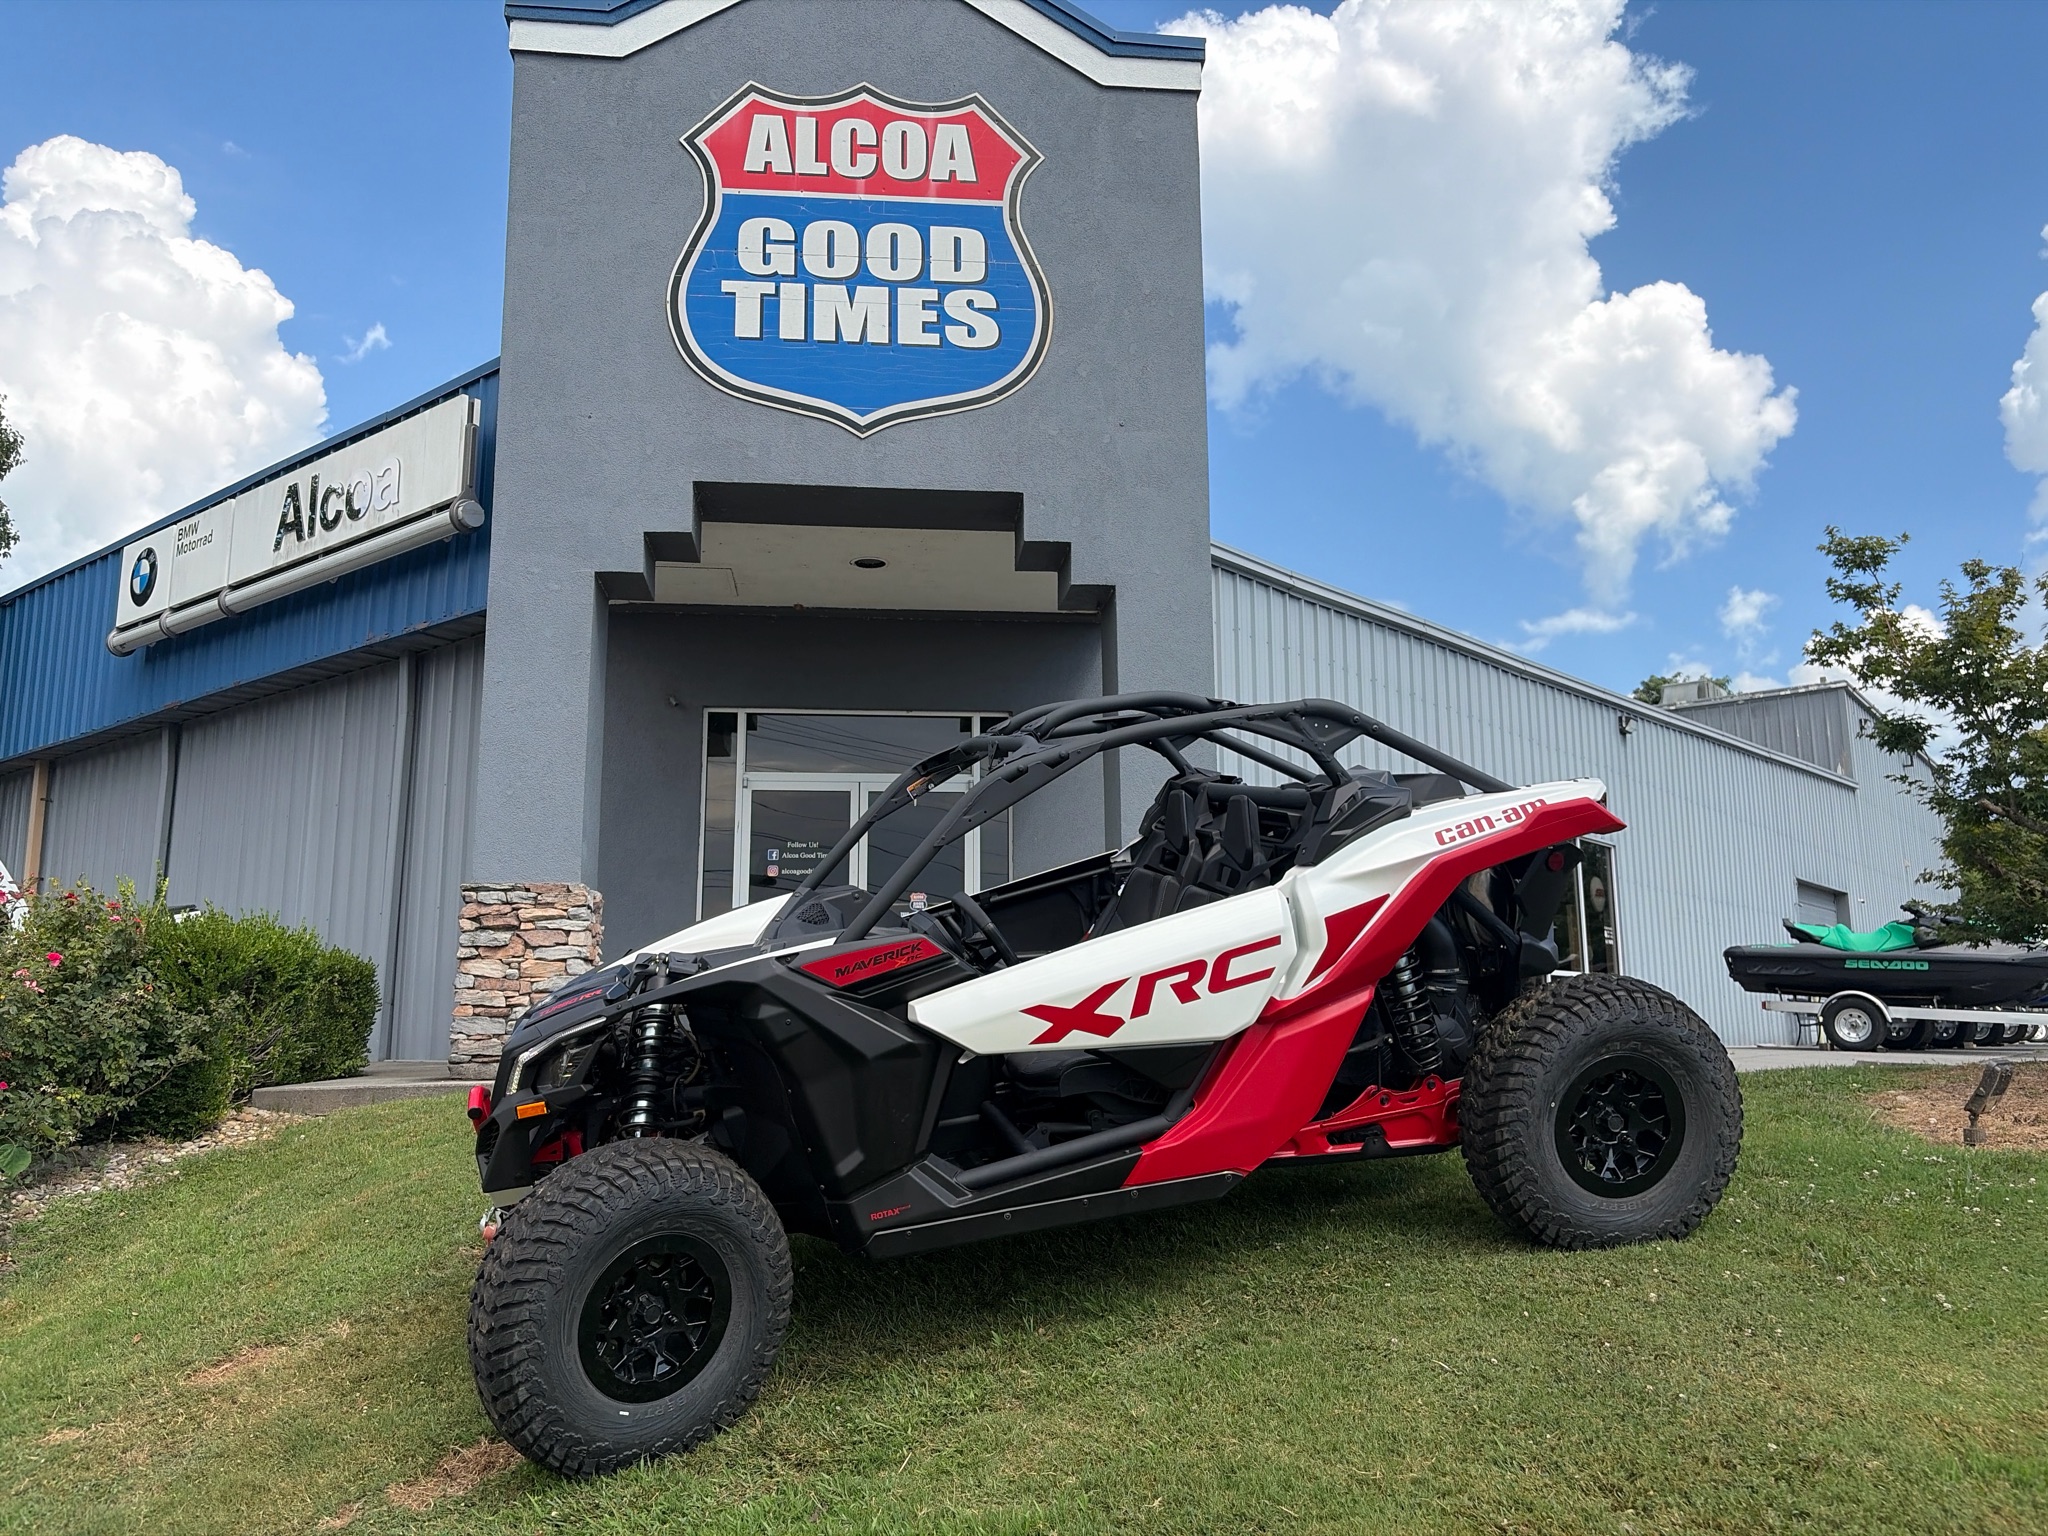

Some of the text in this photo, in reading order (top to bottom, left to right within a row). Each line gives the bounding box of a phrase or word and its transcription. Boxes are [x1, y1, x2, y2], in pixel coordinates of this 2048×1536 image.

[743, 114, 980, 183] ALCOA
[737, 217, 988, 284] GOOD
[721, 280, 1001, 349] TIMES
[272, 457, 401, 553] Alcoa
[175, 528, 214, 558] Motorrad
[177, 520, 200, 542] BMW
[1434, 798, 1548, 847] can-am
[781, 868, 815, 876] alcoagoodt
[834, 941, 923, 978] MAVERICK
[1020, 935, 1282, 1045] XRC
[870, 1207, 900, 1221] ROTAX
